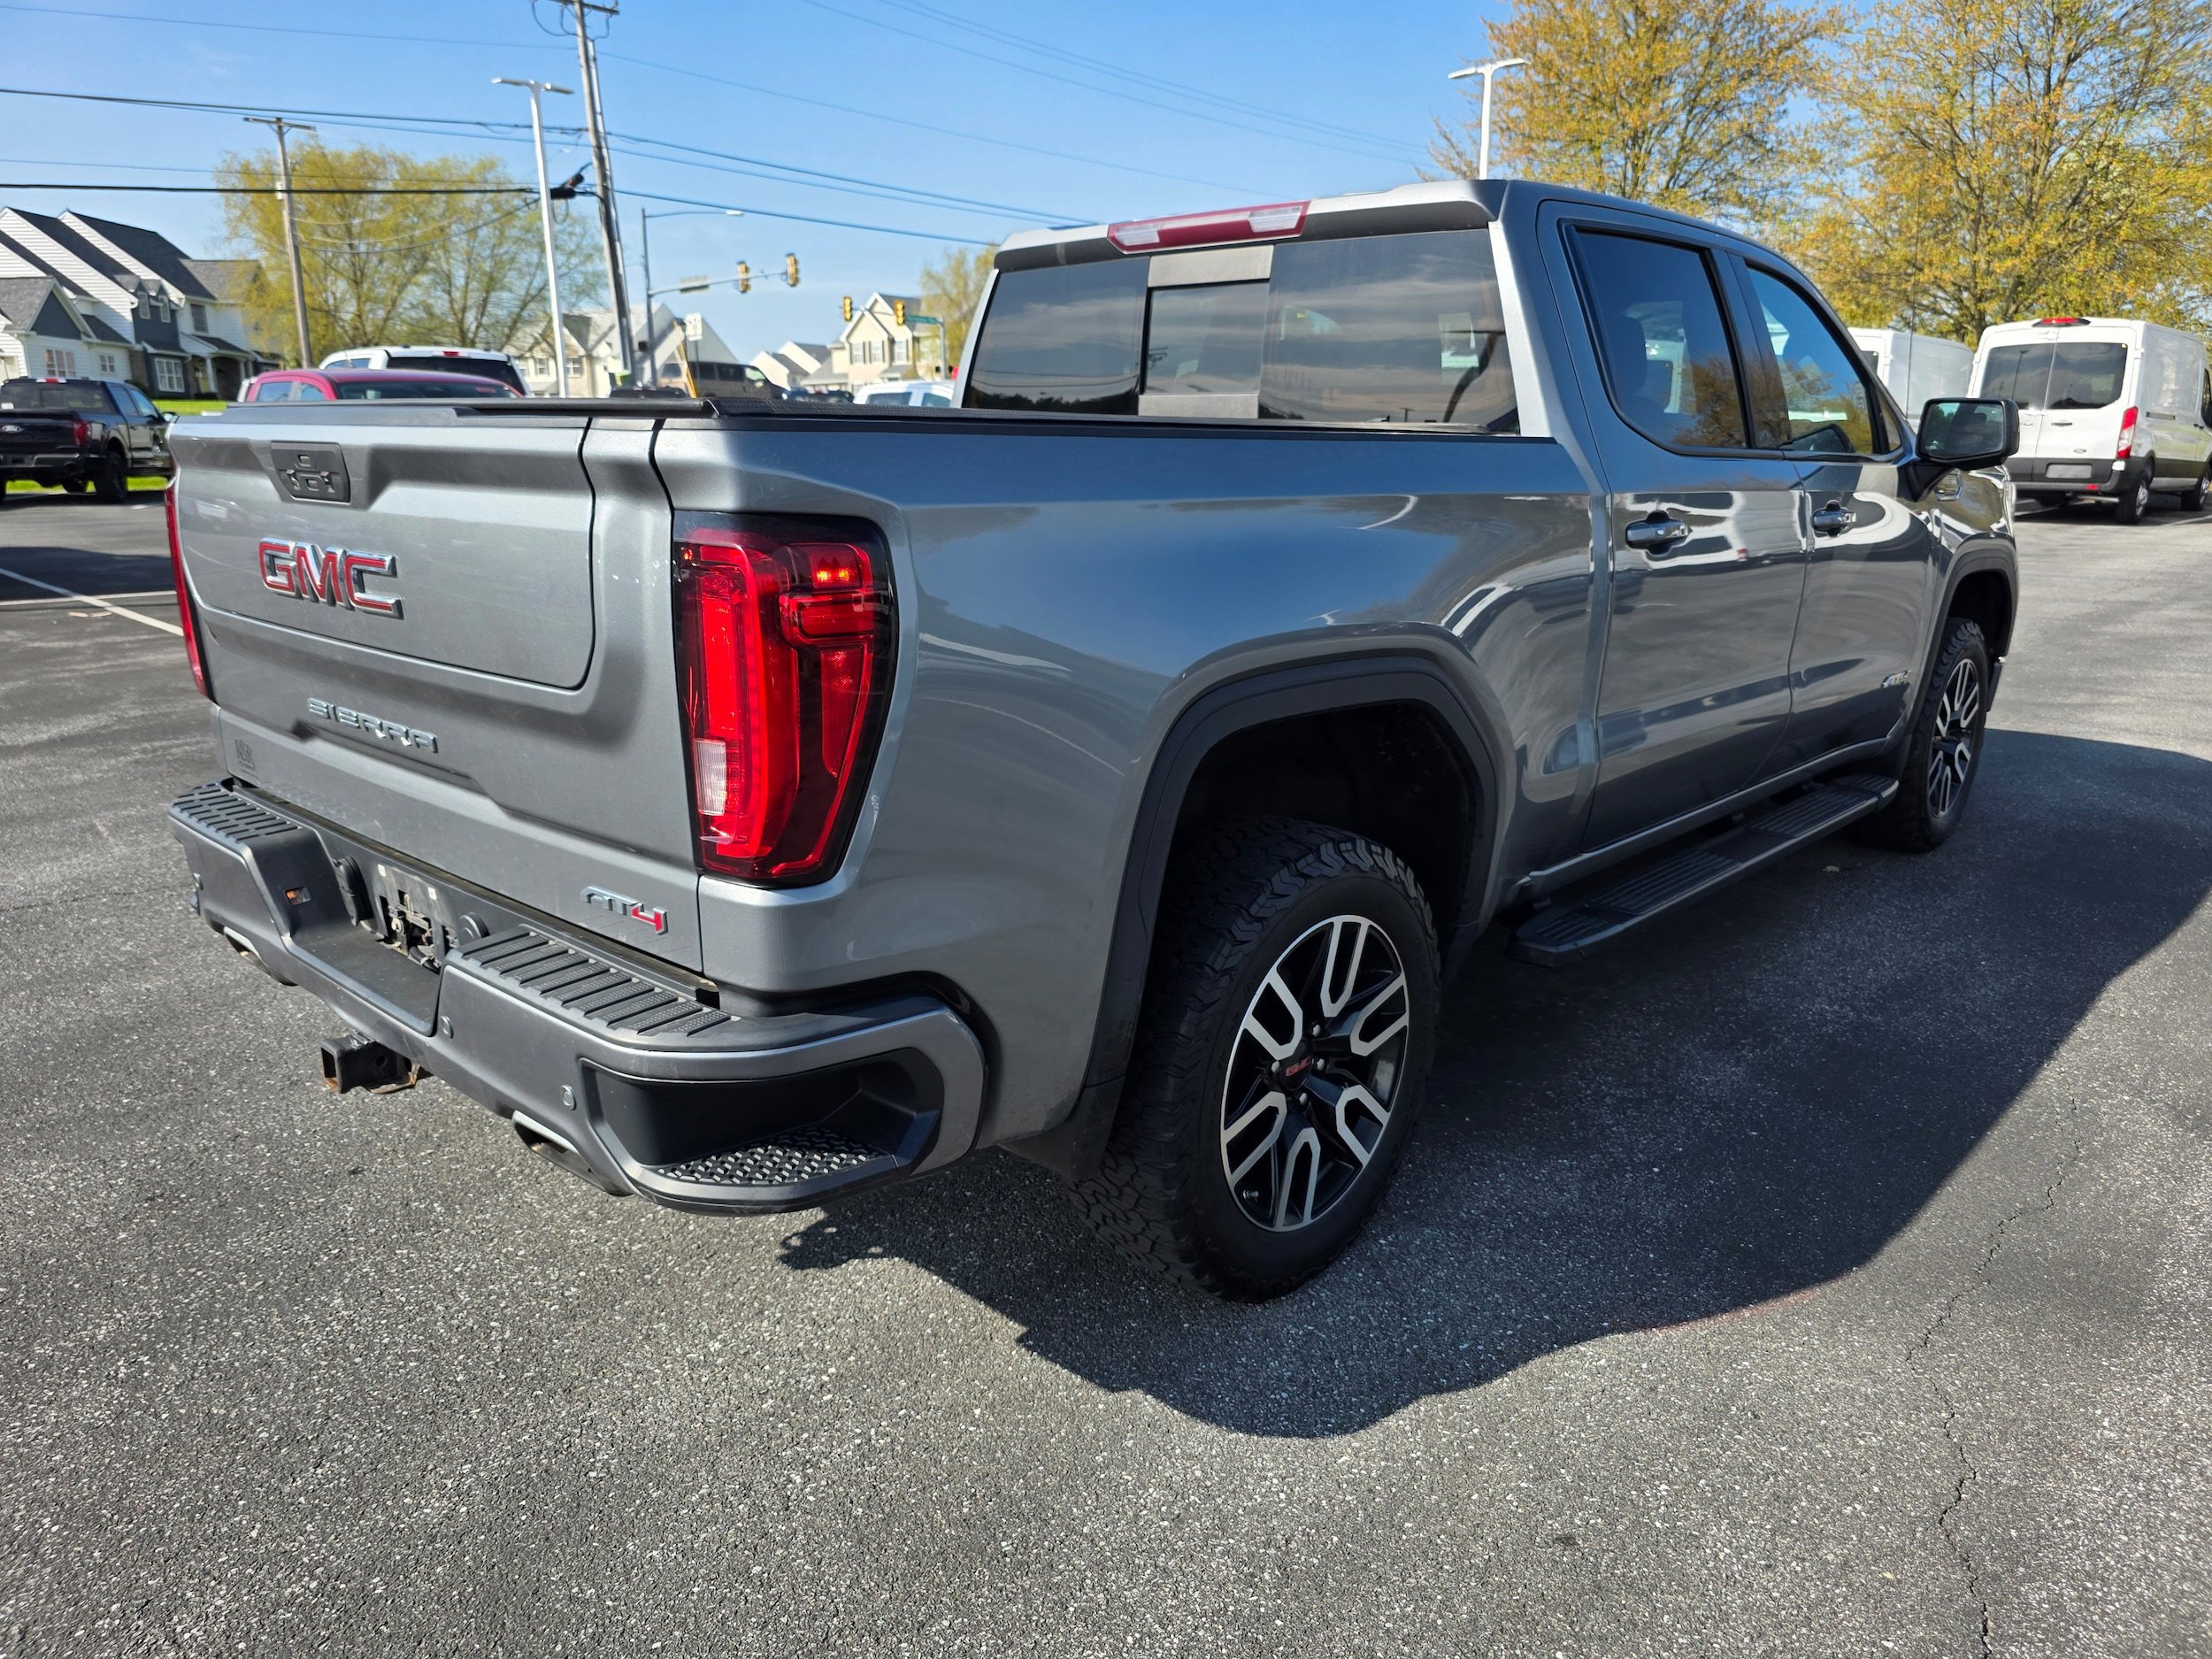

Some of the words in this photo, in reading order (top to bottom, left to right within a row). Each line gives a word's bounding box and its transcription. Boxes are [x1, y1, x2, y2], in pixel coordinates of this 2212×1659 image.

[259, 537, 404, 619] GMC
[307, 697, 439, 754] SIERRA
[580, 886, 668, 935] AT4
